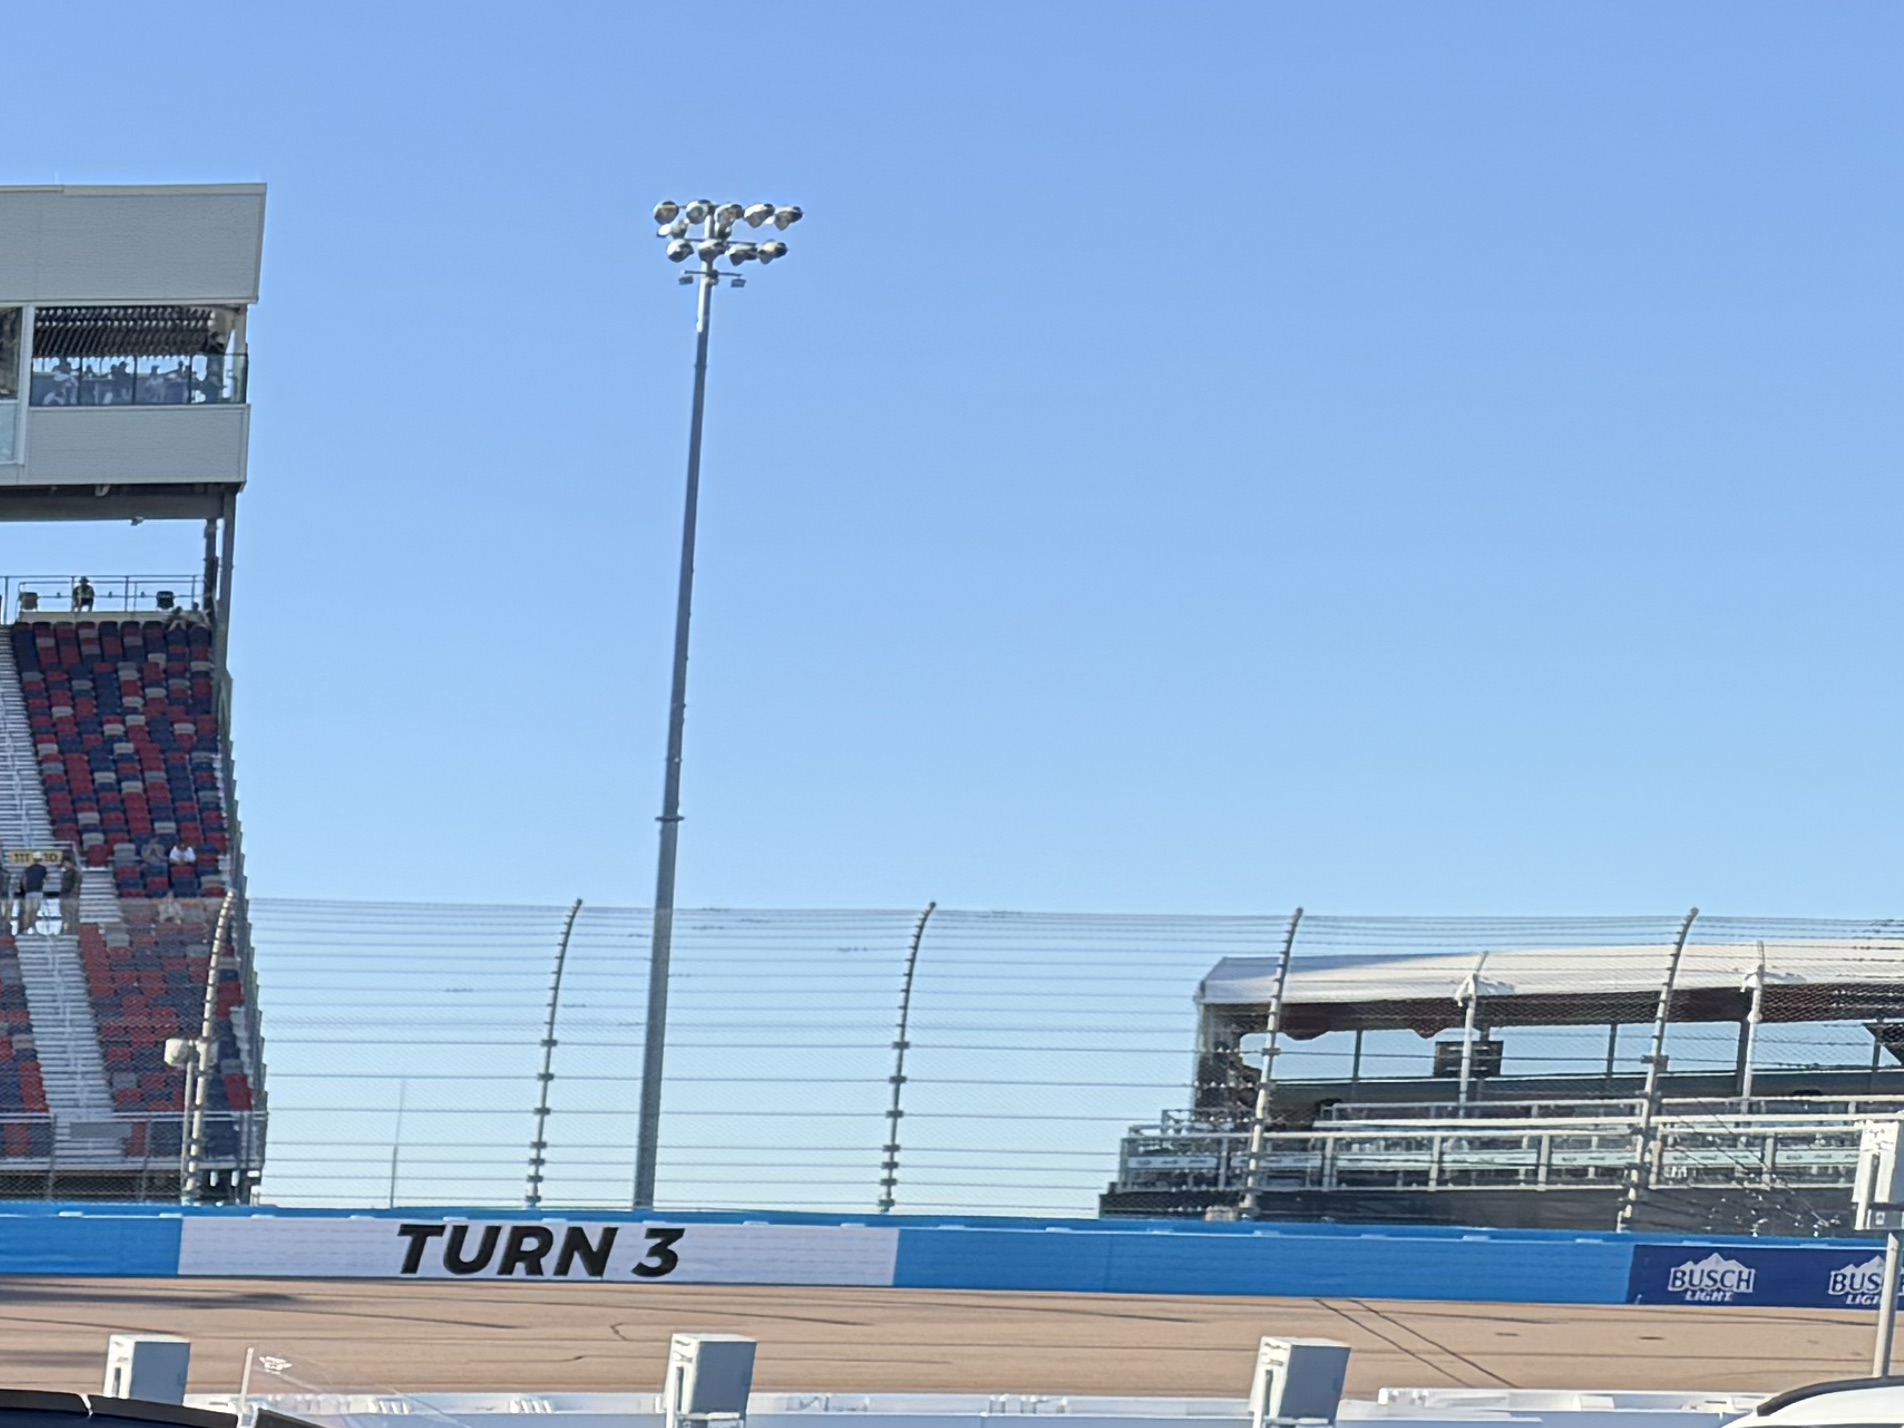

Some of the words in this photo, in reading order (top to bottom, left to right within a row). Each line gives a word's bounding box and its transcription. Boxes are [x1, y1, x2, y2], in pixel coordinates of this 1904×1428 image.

[397, 1224, 619, 1277] TURN
[631, 1227, 686, 1277] 3
[1669, 1268, 1756, 1293] BUSCH
[1829, 1271, 1896, 1295] BUS
[1684, 1290, 1734, 1302] LIGHT
